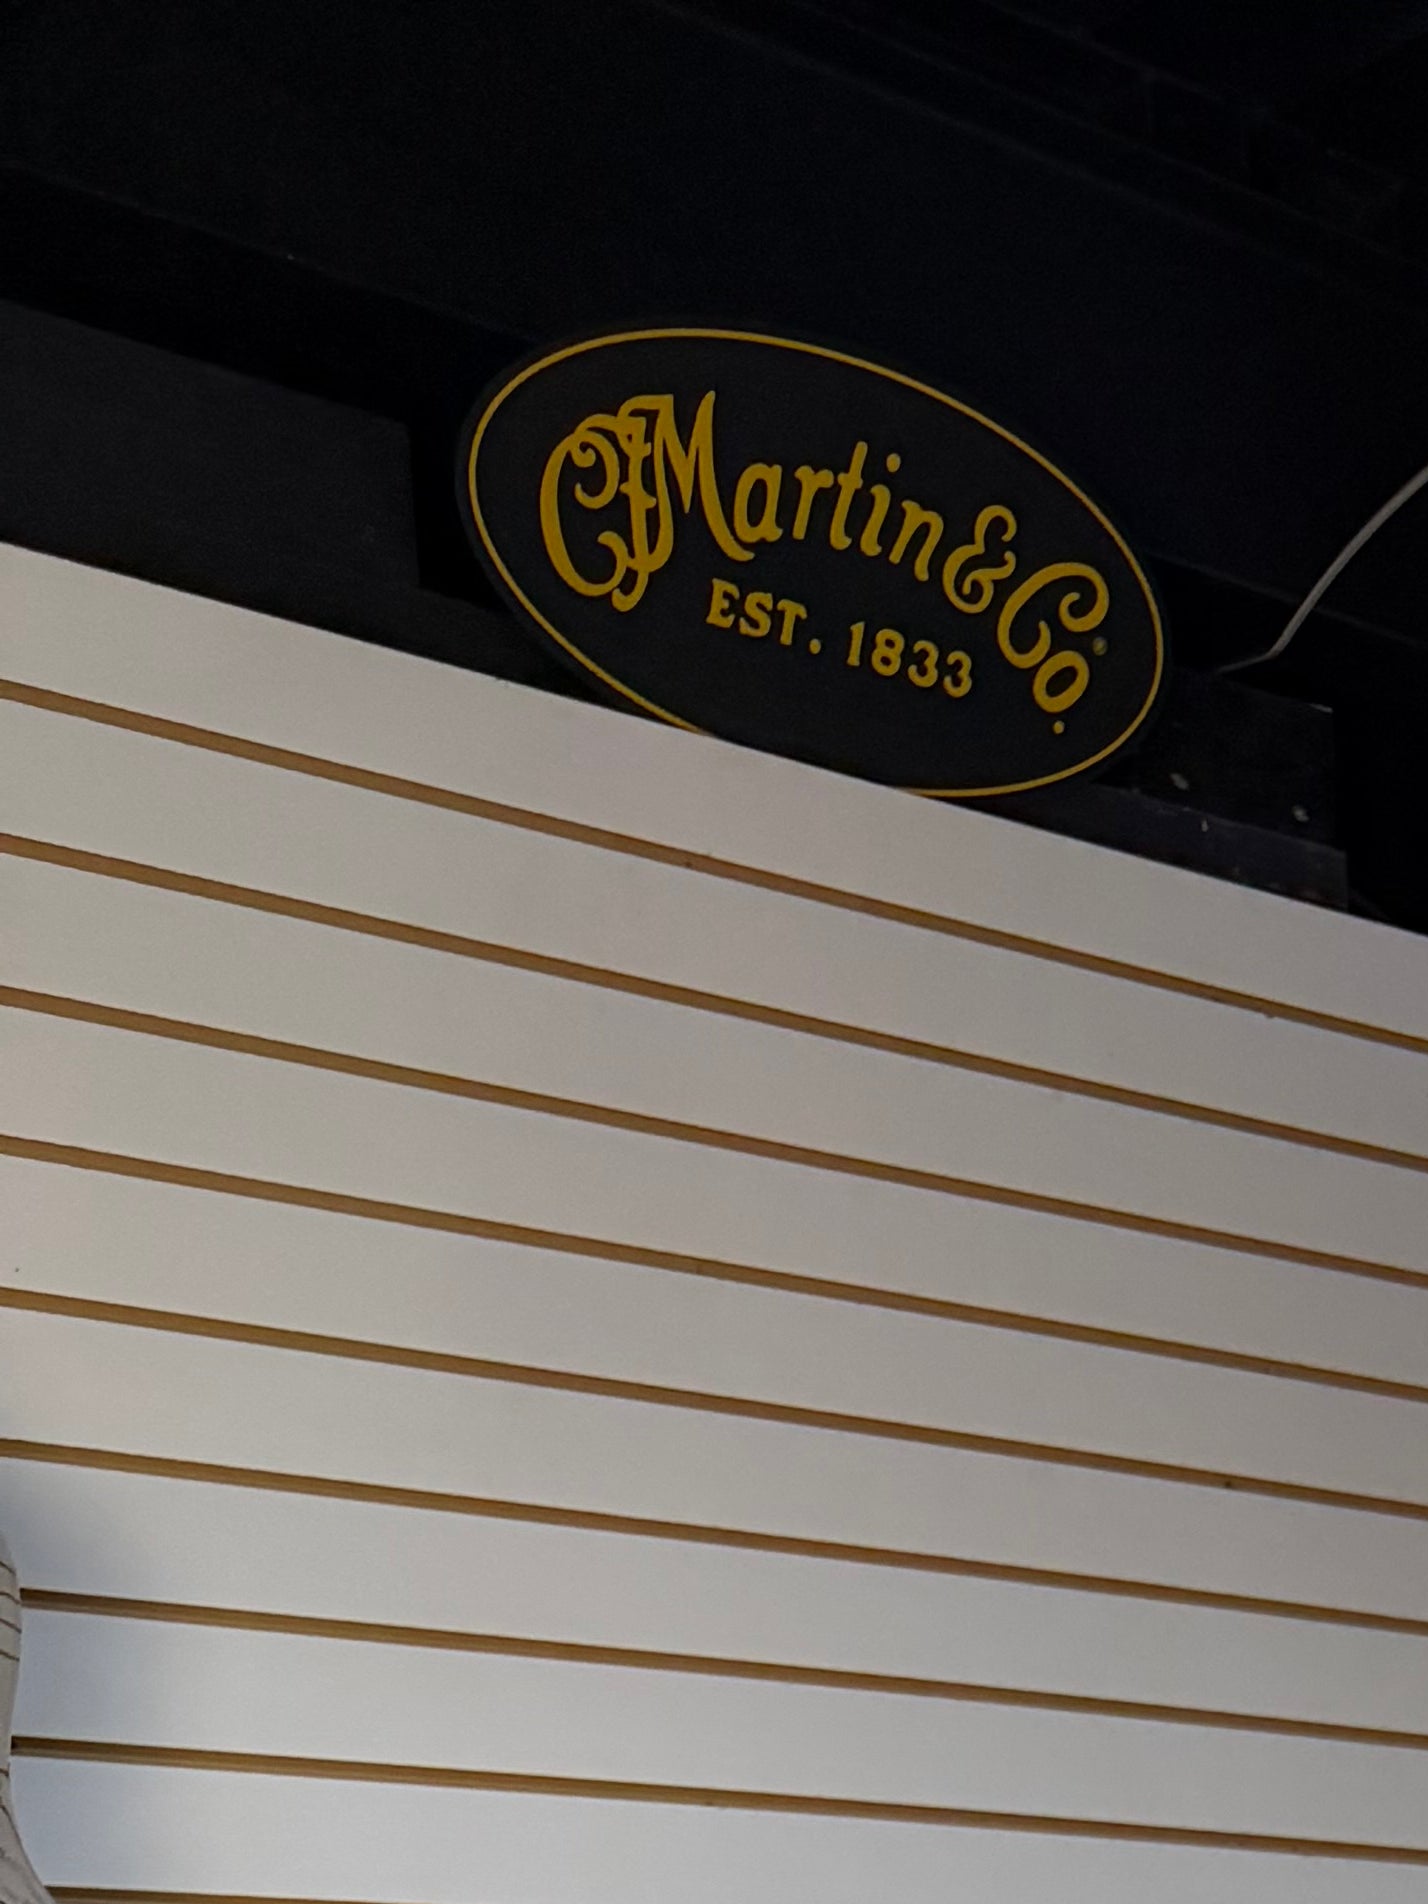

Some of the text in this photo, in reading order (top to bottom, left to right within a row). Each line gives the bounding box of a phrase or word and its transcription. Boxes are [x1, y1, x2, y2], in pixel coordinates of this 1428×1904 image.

[943, 506, 1017, 614] &
[705, 578, 973, 698] EST. 1833
